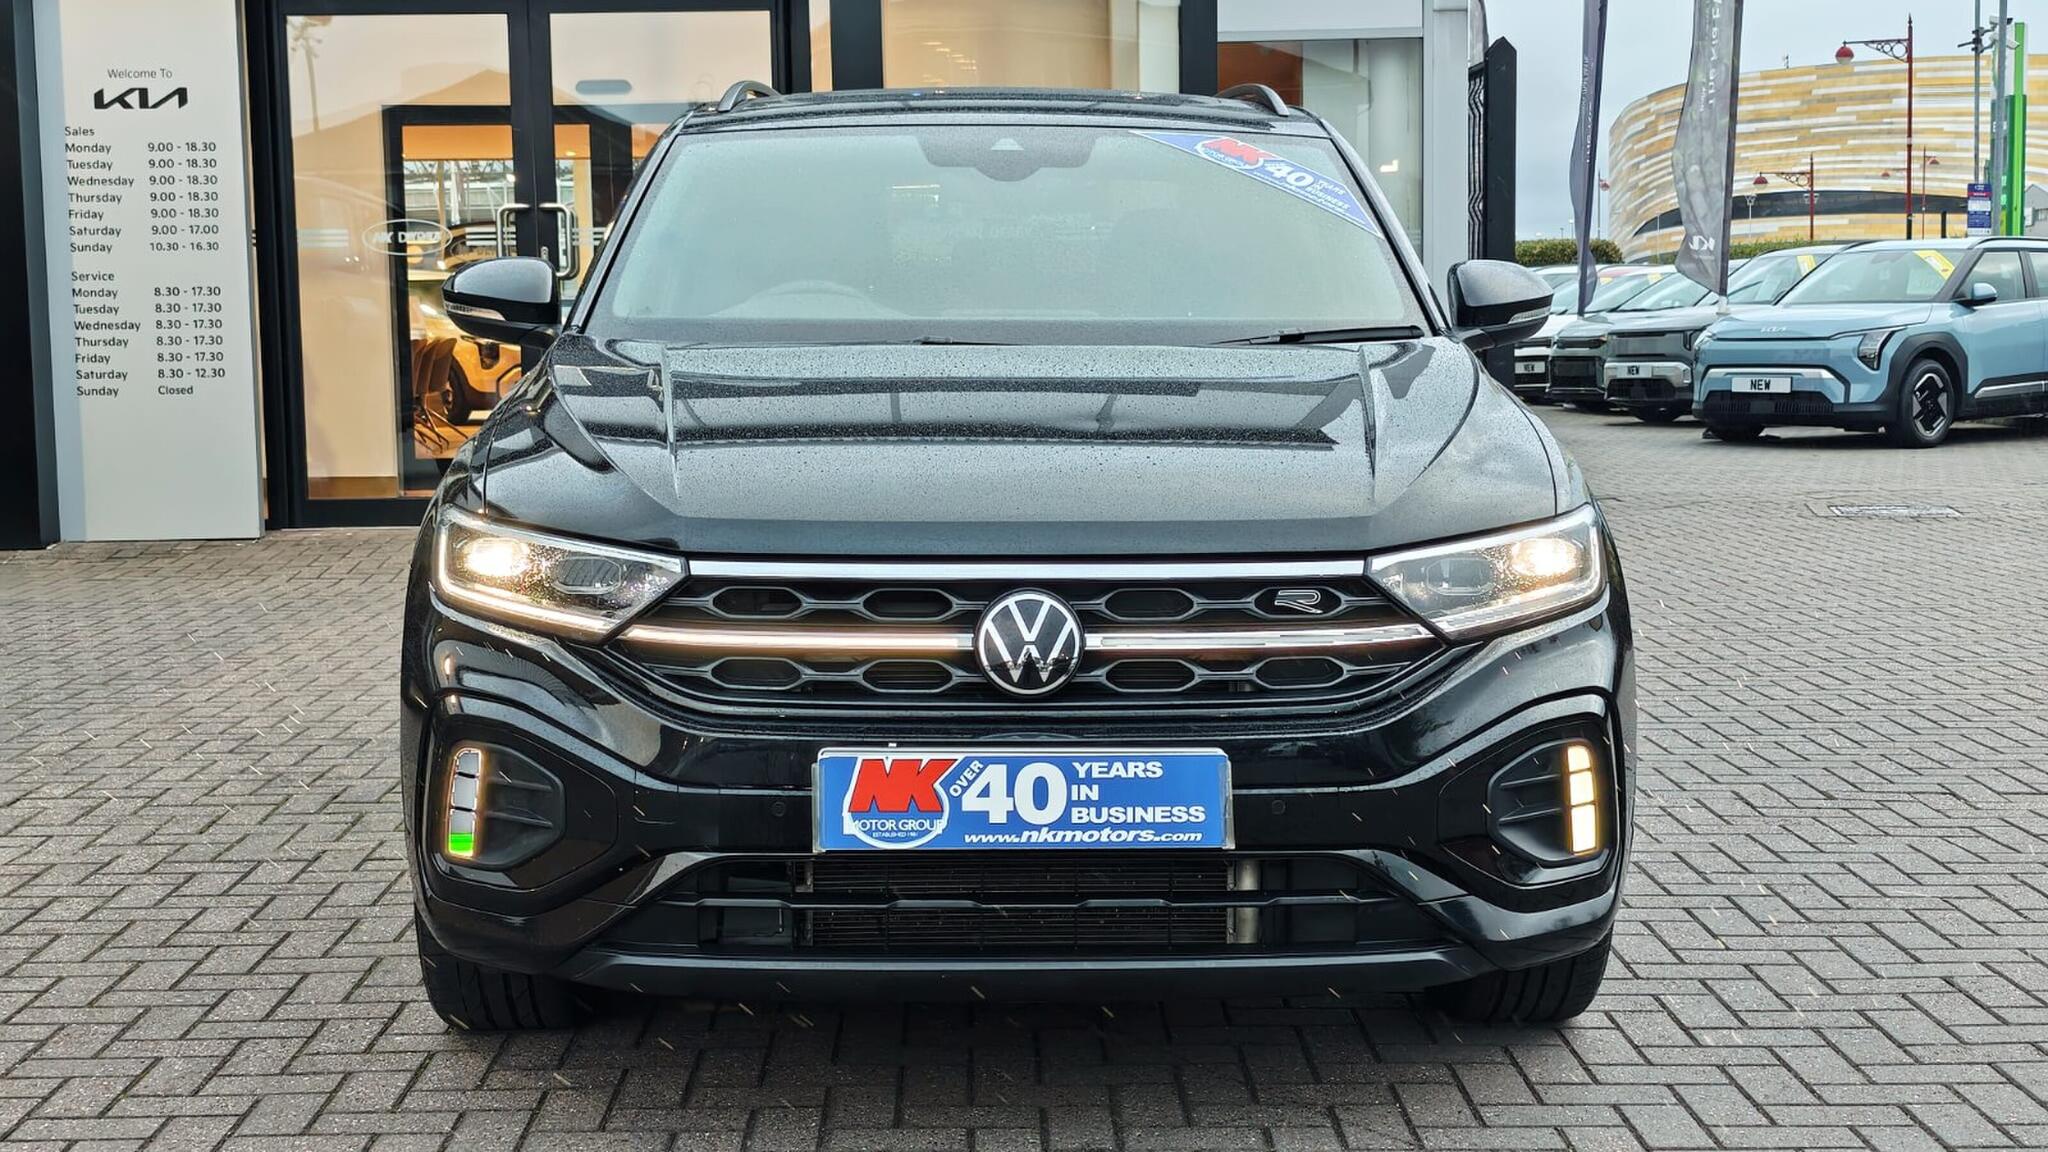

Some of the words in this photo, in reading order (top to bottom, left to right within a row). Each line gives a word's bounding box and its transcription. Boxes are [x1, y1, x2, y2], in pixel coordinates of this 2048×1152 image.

[106, 68, 158, 81] Welcome
[159, 67, 173, 80] To
[93, 86, 189, 110] KIA
[64, 125, 96, 137] Sales
[64, 142, 112, 156] Monday
[147, 141, 174, 153] 9.00
[184, 141, 217, 153] 18.30
[65, 159, 114, 172] Tuesday
[147, 157, 175, 169] 9.00
[185, 157, 218, 169] 18.30
[66, 175, 135, 188] Wednesday
[148, 174, 176, 187] 9.00
[186, 174, 219, 186] 18.30
[1265, 164, 1315, 187] 40
[67, 192, 123, 206] Thursday
[149, 191, 177, 203] 9.00
[187, 191, 219, 202] 18.30
[68, 207, 105, 222] Friday
[150, 207, 178, 219] 9.00
[187, 207, 220, 219] 18.30
[68, 225, 122, 238] Saturday
[151, 224, 178, 236] 9.00
[188, 224, 220, 235] 17.00
[69, 241, 113, 255] Sunday
[149, 241, 180, 252] 10.30
[189, 240, 220, 252] 16.30
[71, 270, 115, 282] Service
[71, 287, 119, 300] Monday
[153, 286, 181, 297] 8.30
[191, 285, 222, 297] 17.30
[72, 303, 120, 317] Tuesday
[154, 302, 182, 314] 8.30
[191, 301, 223, 314] 17.30
[73, 319, 142, 333] Wednesday
[155, 319, 182, 330] 8.30
[192, 318, 223, 330] 17.30
[74, 335, 129, 350] Thursday
[155, 335, 183, 347] 8.30
[192, 334, 224, 347] 17.30
[74, 352, 111, 366] Friday
[156, 351, 184, 363] 8.30
[193, 351, 224, 362] 17.30
[75, 368, 129, 382] Saturday
[157, 367, 185, 380] 8.30
[194, 367, 226, 379] 12.30
[1627, 364, 1640, 376] NEW
[76, 385, 120, 398] Sunday
[157, 384, 194, 396] Closed
[1750, 378, 1772, 391] NEW
[1071, 761, 1164, 779] YEARS
[848, 758, 959, 813] NK
[949, 760, 985, 798] OVER
[961, 761, 1068, 826] 40
[1071, 784, 1099, 801] IN
[1071, 806, 1207, 824] BUSINESS
[964, 826, 1203, 844] www.nkmotors.com
